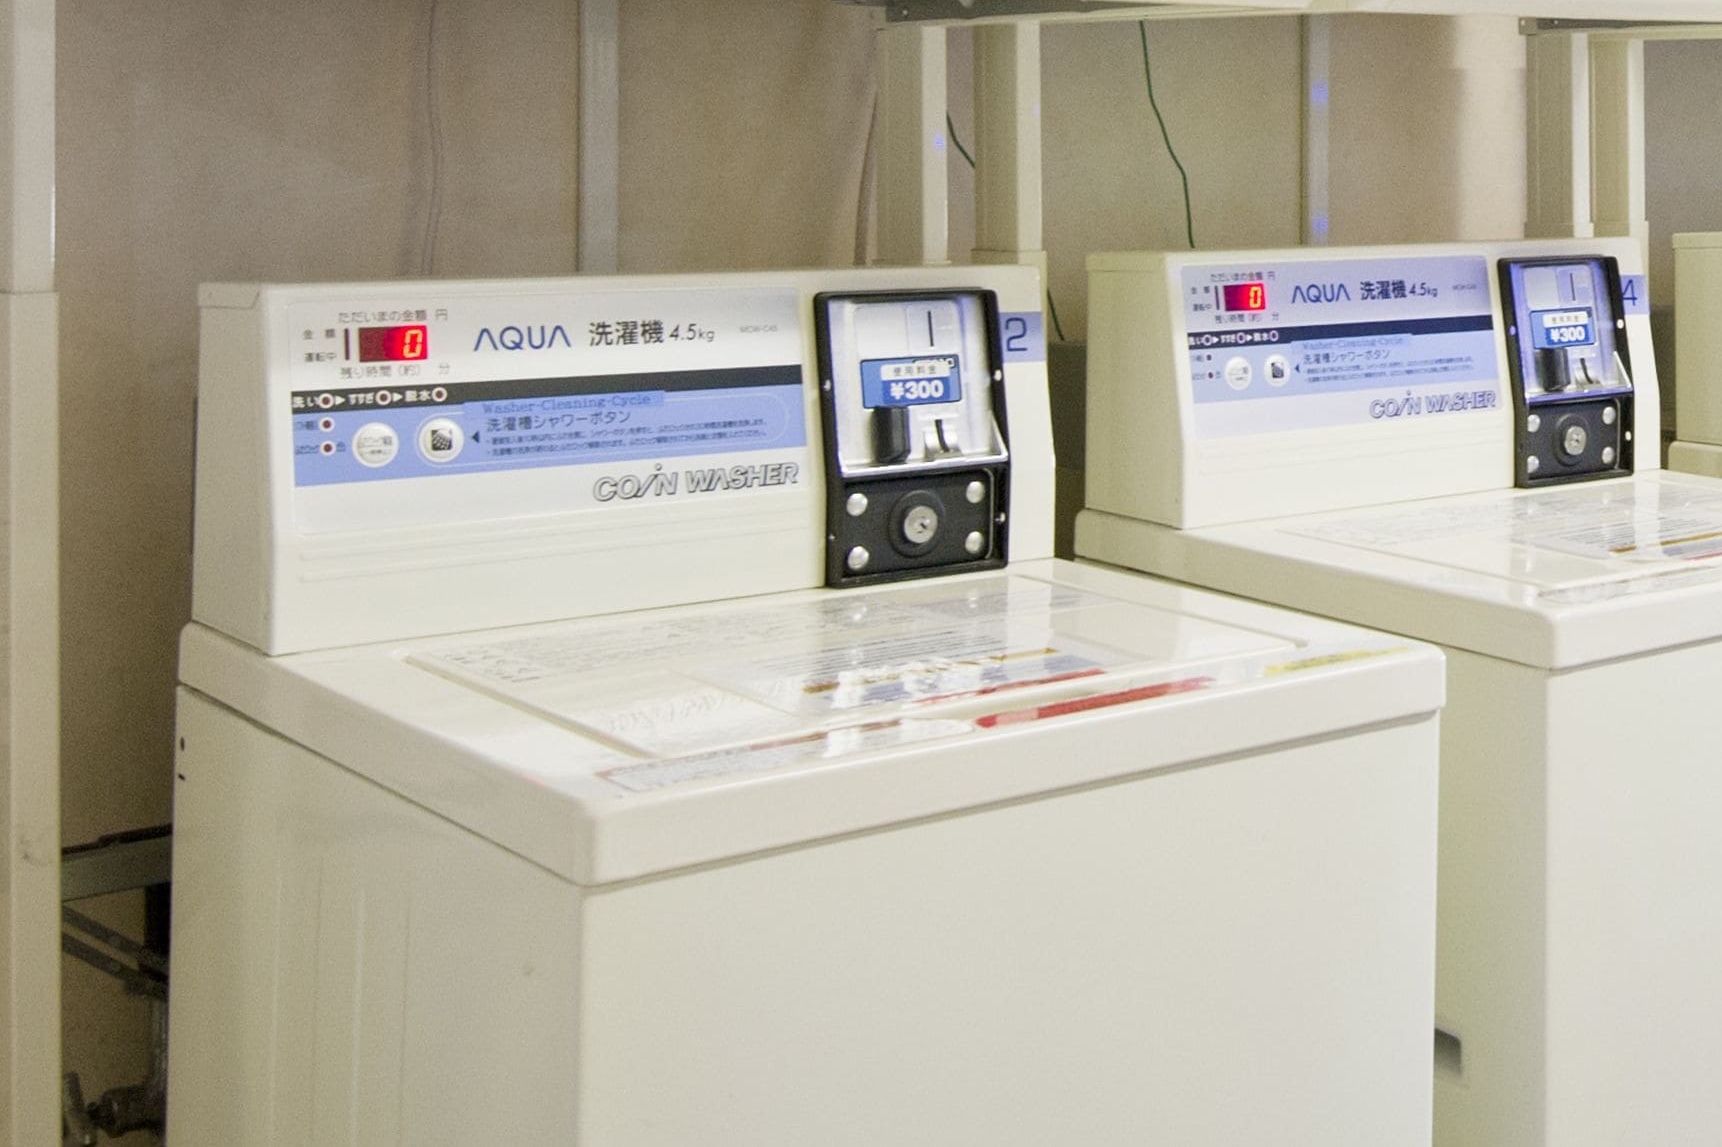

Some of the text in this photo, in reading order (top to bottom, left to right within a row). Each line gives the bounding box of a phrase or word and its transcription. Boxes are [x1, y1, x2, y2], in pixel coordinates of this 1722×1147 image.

[1249, 285, 1262, 309] 0
[1291, 283, 1352, 304] AQUA
[1360, 279, 1438, 301] 洗濯機 4.5kg
[1623, 278, 1638, 307] 4
[338, 309, 448, 323] ただいまの金額 円
[402, 328, 423, 359] 0
[473, 324, 572, 352] AQUA
[588, 319, 716, 348] 洗濯機 4.5kg
[1005, 316, 1028, 352] 2
[1550, 325, 1586, 343] ¥300
[304, 352, 337, 363] 運転中
[438, 364, 451, 376] 分
[892, 363, 938, 377] 使用料金
[890, 380, 945, 400] ¥300
[1426, 390, 1497, 413] WASHER
[486, 410, 631, 432] 洗濯槽シャワーボタン
[685, 461, 799, 494] WASHER
